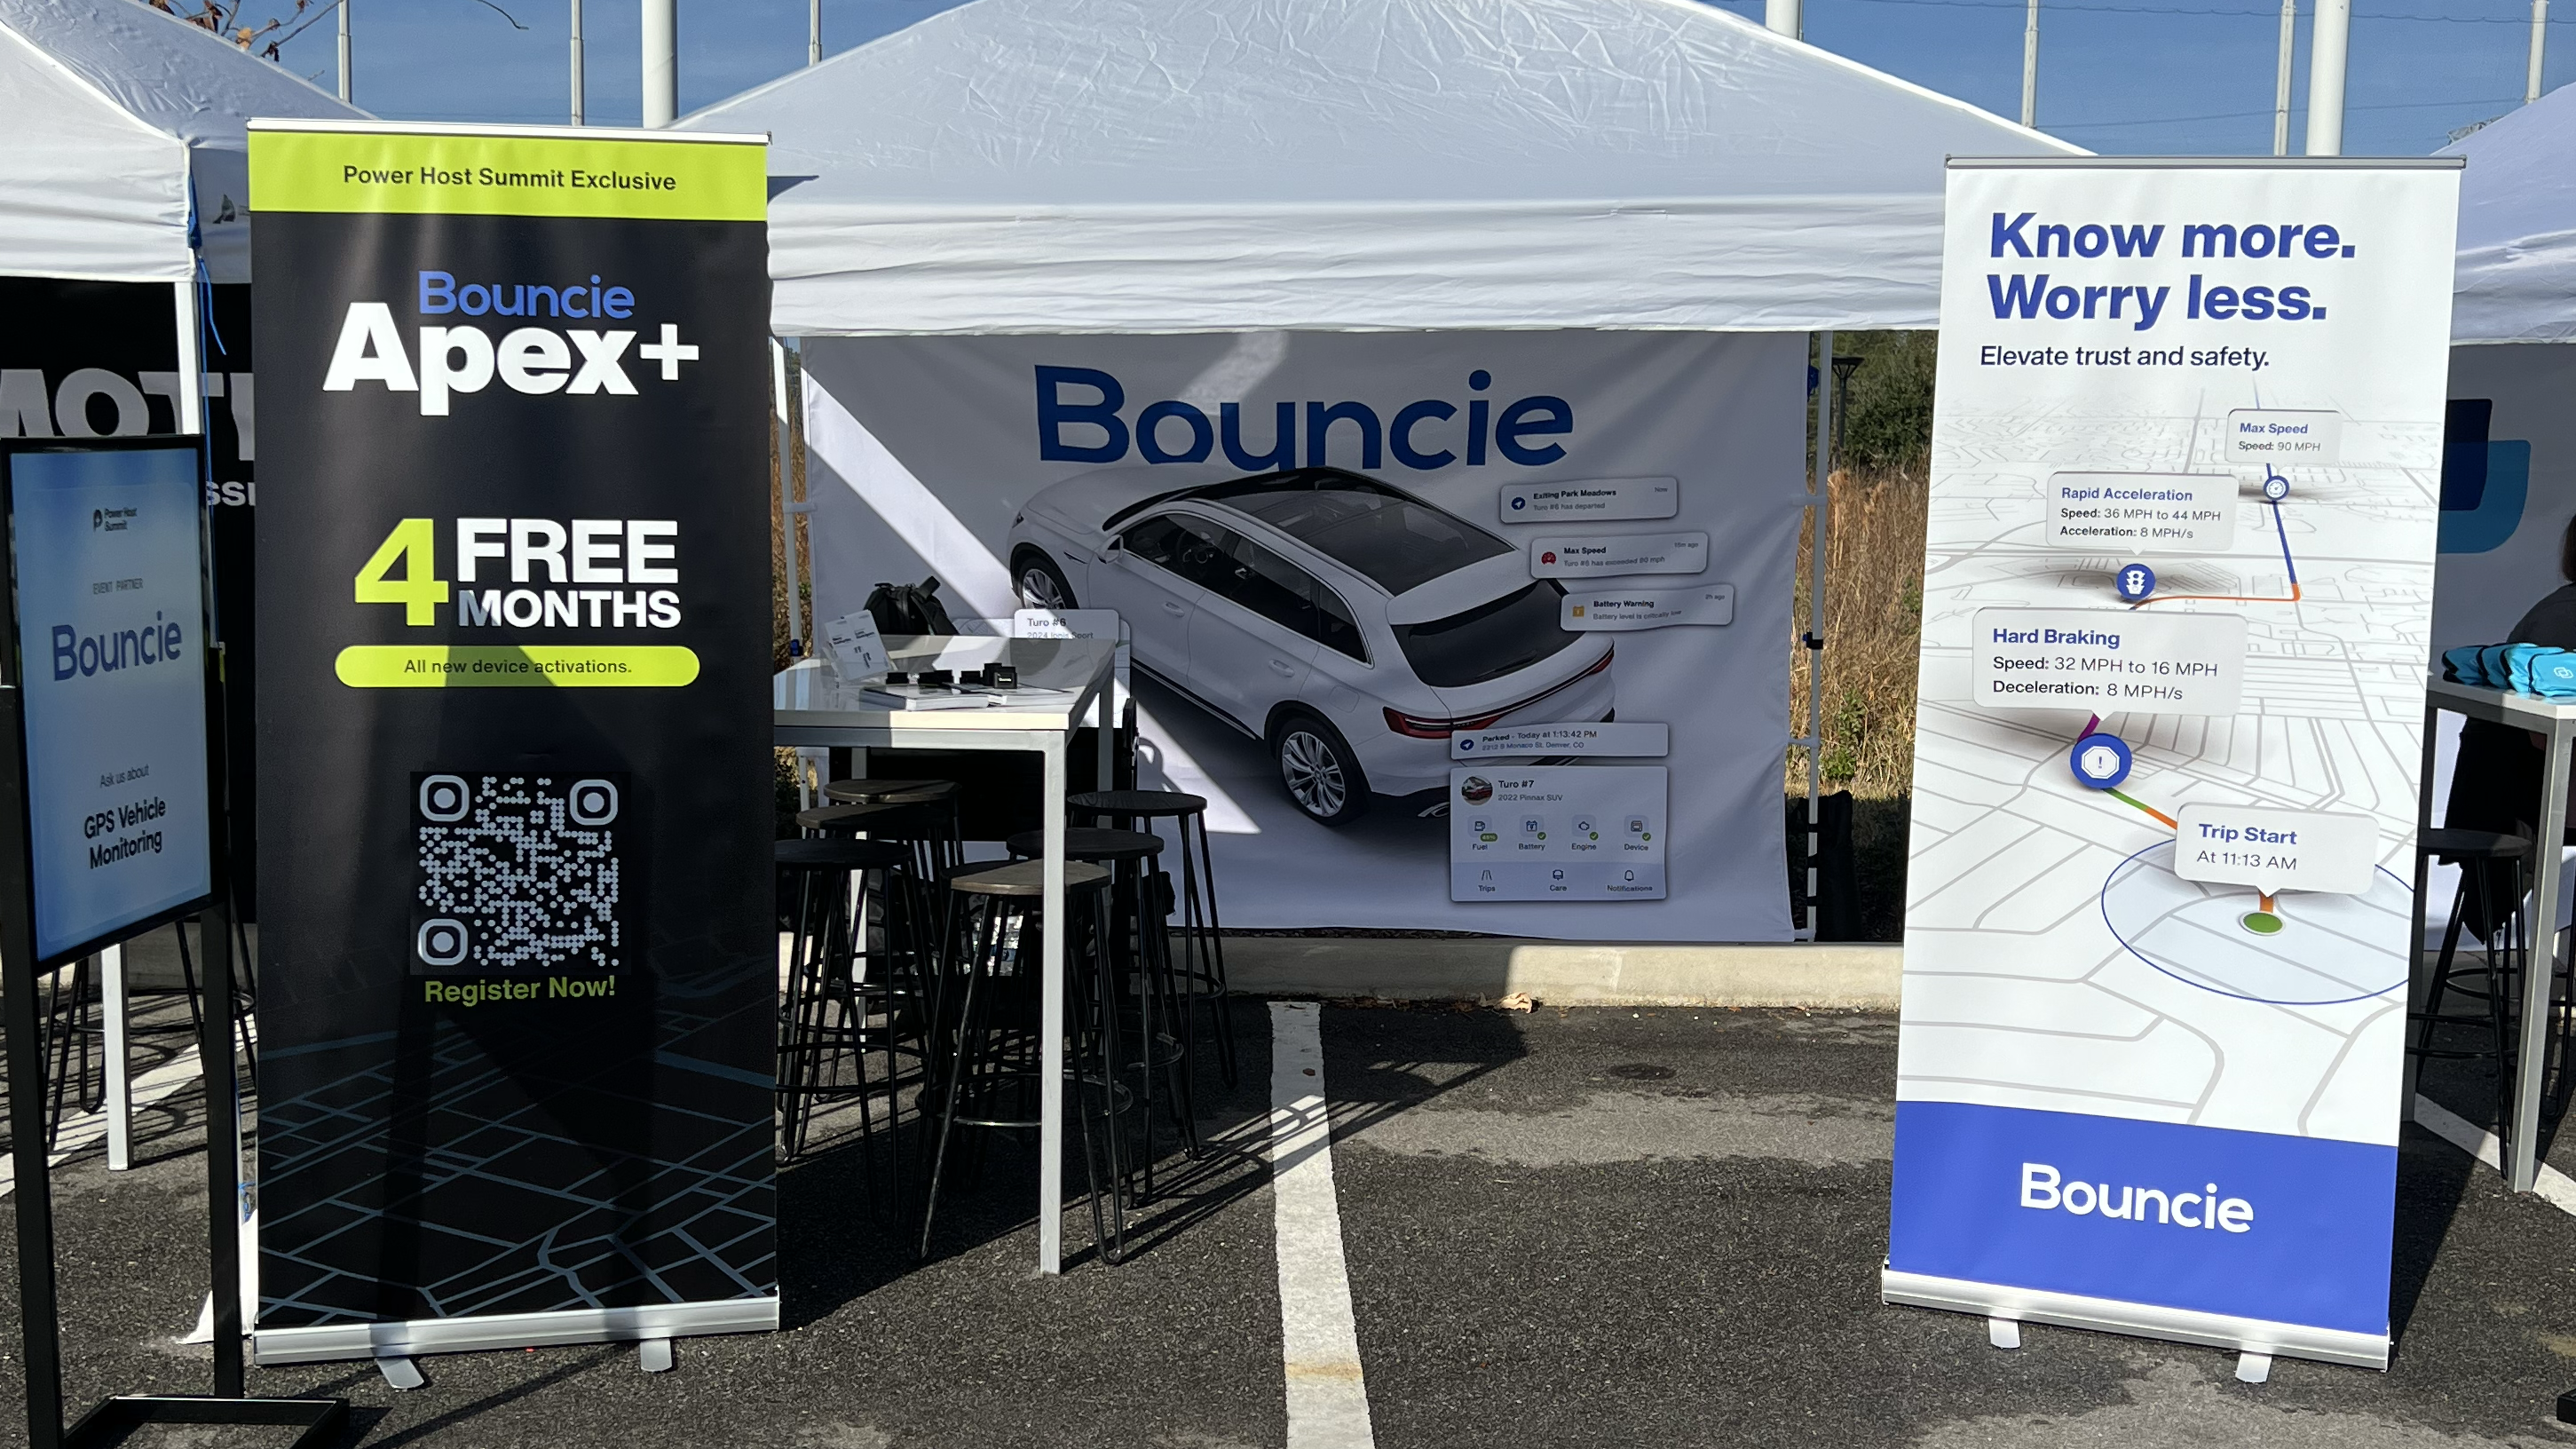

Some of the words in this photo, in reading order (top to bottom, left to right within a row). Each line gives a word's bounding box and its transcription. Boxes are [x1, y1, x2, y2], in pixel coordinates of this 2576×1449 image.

[344, 165, 413, 184] Power
[421, 166, 472, 186] Host
[478, 168, 565, 187] Summit
[571, 170, 676, 191] Exclusive
[1990, 212, 2165, 258] Know
[2182, 224, 2356, 258] more.
[418, 270, 636, 319] Bouncie
[1987, 273, 2170, 331] Worry
[2187, 273, 2327, 321] less.
[322, 302, 699, 416] Apex+
[1980, 345, 2069, 367] Elevate
[2075, 347, 2131, 367] trust
[2137, 346, 2183, 367] and
[2190, 346, 2270, 371] safety.
[1034, 364, 1574, 472] Bouncie
[2240, 423, 2265, 433] Max
[2268, 423, 2308, 435] Speed
[2238, 440, 2274, 451] Speed:
[2277, 442, 2292, 452] 90
[2295, 442, 2321, 452] MPH
[2061, 487, 2100, 502] Rapid
[2104, 488, 2193, 502] Acceleration
[2060, 508, 2100, 519] Speed:
[2104, 509, 2120, 519] 36
[2123, 509, 2153, 519] MPH
[2156, 510, 2168, 520] to
[2172, 510, 2189, 520] 44
[2193, 511, 2221, 521] MPH
[2059, 526, 2137, 537] Acceleration:
[2140, 527, 2149, 537] 8
[2152, 527, 2193, 539] MPH/s
[1582, 547, 1607, 556] Speed
[355, 518, 449, 626] 4
[457, 518, 679, 583] FREE
[116, 578, 144, 592] PARTNER
[458, 589, 682, 628] MONTHS
[1593, 600, 1622, 609] Battery
[1027, 618, 1050, 627] Turo
[51, 610, 183, 682] Bouncie
[1993, 628, 2039, 644] Hard
[2044, 629, 2121, 650] Braking
[404, 660, 426, 673] All
[432, 662, 467, 673] new
[472, 660, 529, 673] device
[534, 660, 632, 673] activations.
[1993, 656, 2050, 673] Speed:
[2054, 657, 2076, 670] 32
[2081, 658, 2123, 672] MPH
[2128, 660, 2146, 674] to
[2152, 661, 2170, 675] 16
[2175, 662, 2218, 677] MPH
[1993, 680, 2099, 696] Deceleration:
[2106, 683, 2118, 696] 8
[2124, 684, 2184, 700] MPH/s
[1482, 733, 1510, 742] Parked
[99, 772, 114, 788] Ask
[116, 772, 125, 784] us
[127, 764, 149, 780] about
[1521, 780, 1534, 788] #7
[84, 810, 115, 839] GPS
[118, 796, 166, 828] Vehicle
[2199, 823, 2240, 843] Trip
[2244, 827, 2297, 844] Start
[90, 829, 162, 869] Monitoring
[2197, 850, 2216, 864] At
[2223, 851, 2261, 867] 11:13
[2266, 856, 2297, 870] AM
[424, 978, 541, 1007] Register
[549, 975, 615, 999] Now!
[2020, 1161, 2254, 1233] Bouncie
